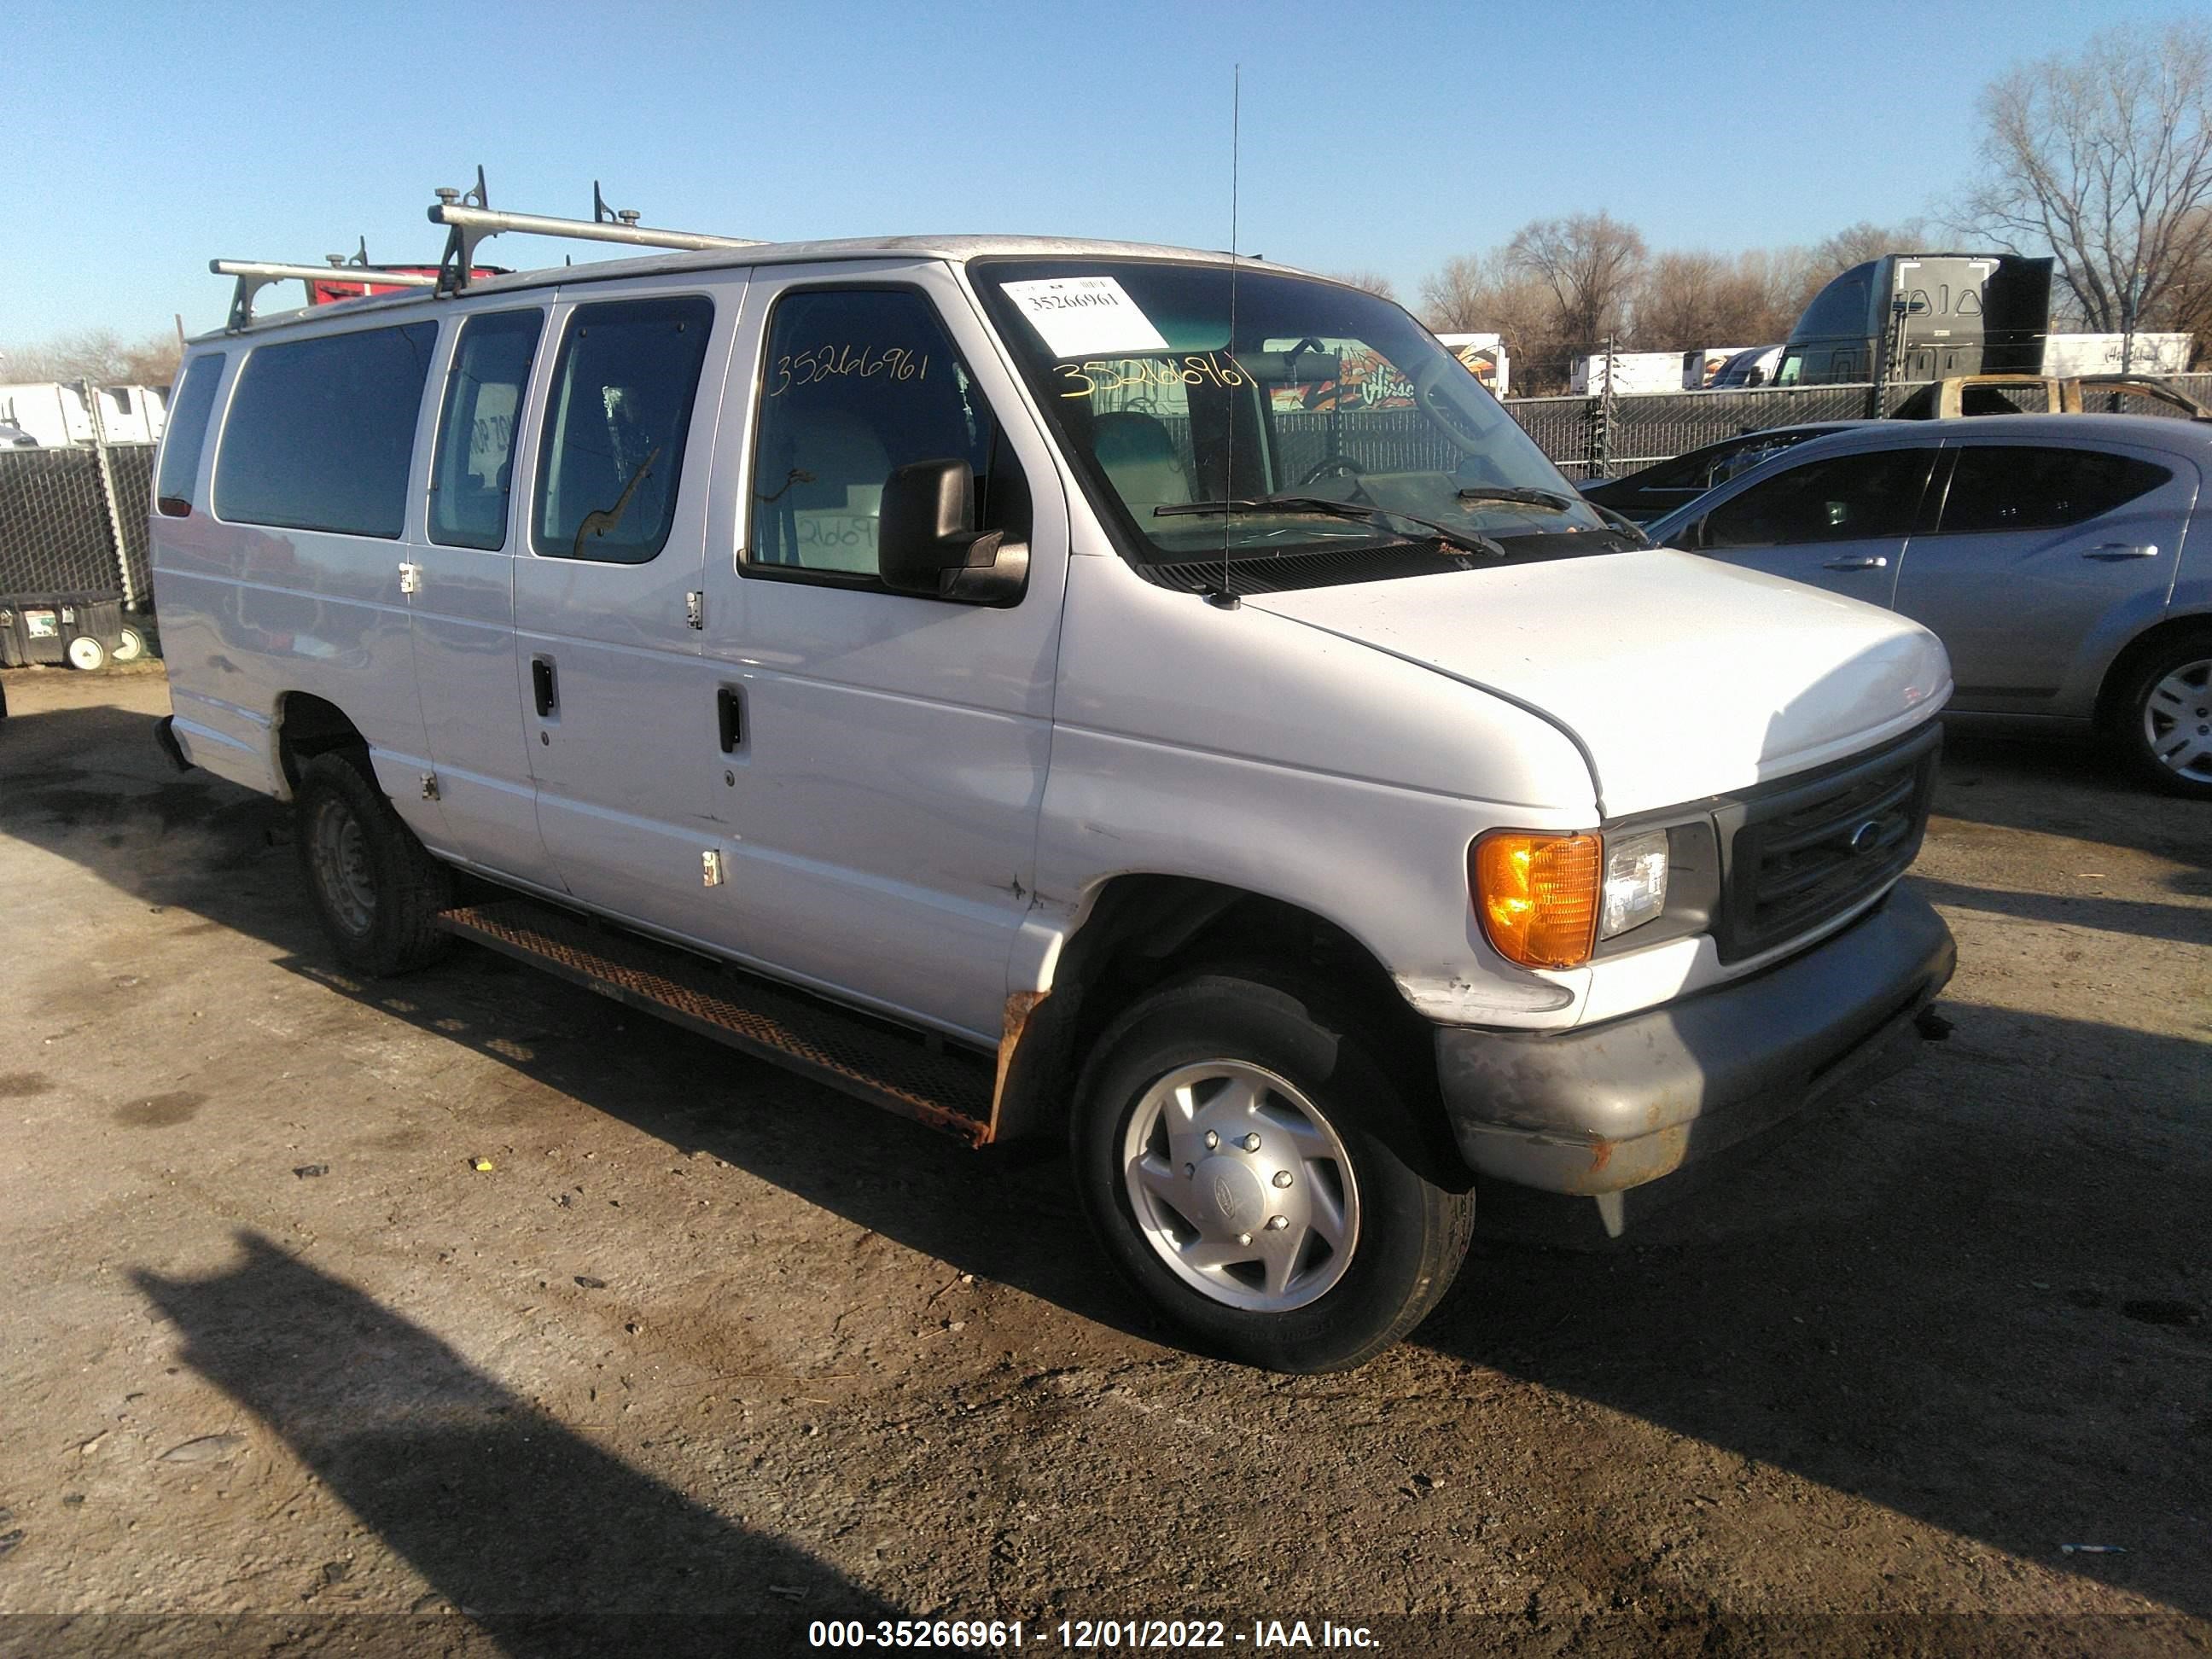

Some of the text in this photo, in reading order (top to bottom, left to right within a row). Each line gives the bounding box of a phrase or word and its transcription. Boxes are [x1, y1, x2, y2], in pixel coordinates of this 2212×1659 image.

[1028, 293, 1120, 311] 35266961
[771, 345, 928, 397] 35266961
[1052, 351, 1259, 398] 35266961
